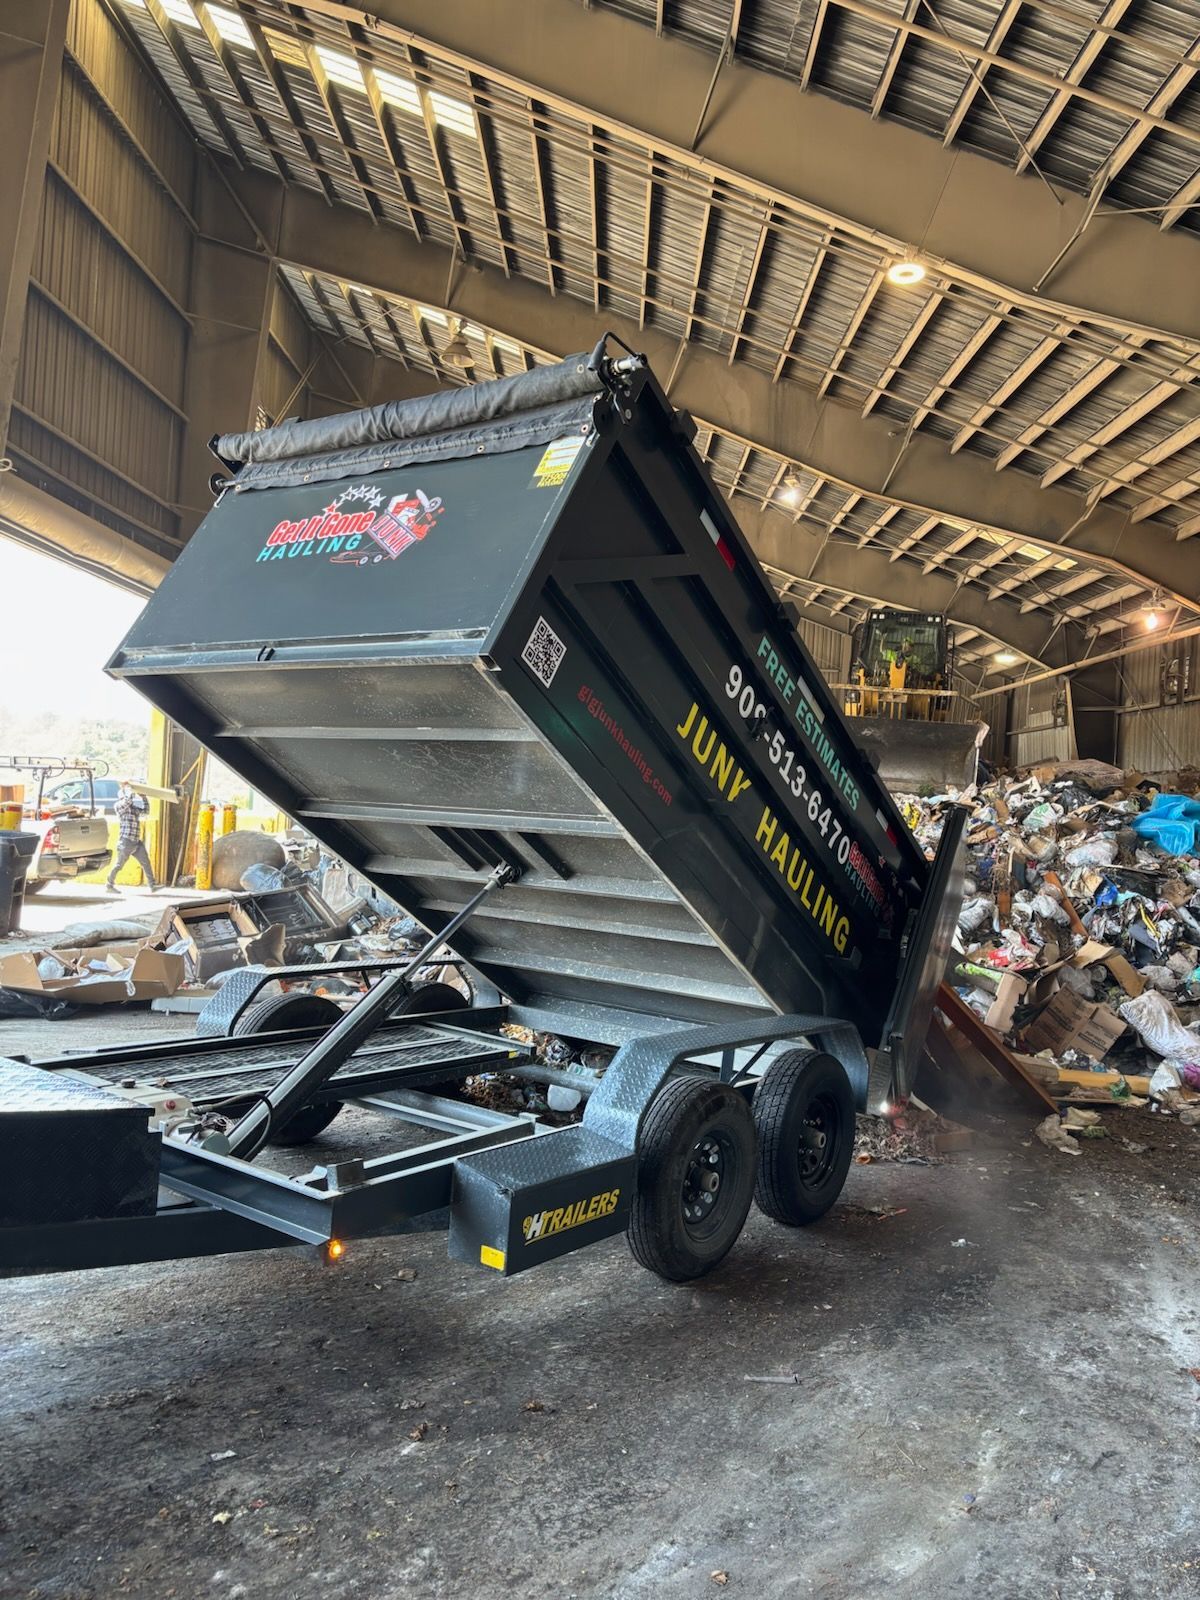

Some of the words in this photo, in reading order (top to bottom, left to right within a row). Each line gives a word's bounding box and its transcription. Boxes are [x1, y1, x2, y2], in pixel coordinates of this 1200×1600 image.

[256, 534, 363, 562] HAULING
[266, 519, 302, 546] Get
[317, 510, 377, 539] Gone
[371, 515, 413, 554] JUNK
[577, 684, 673, 806] gigjunkhauling.com
[757, 636, 796, 704] FREE
[794, 702, 861, 811] ESTIMATES
[755, 806, 850, 955] HAULING
